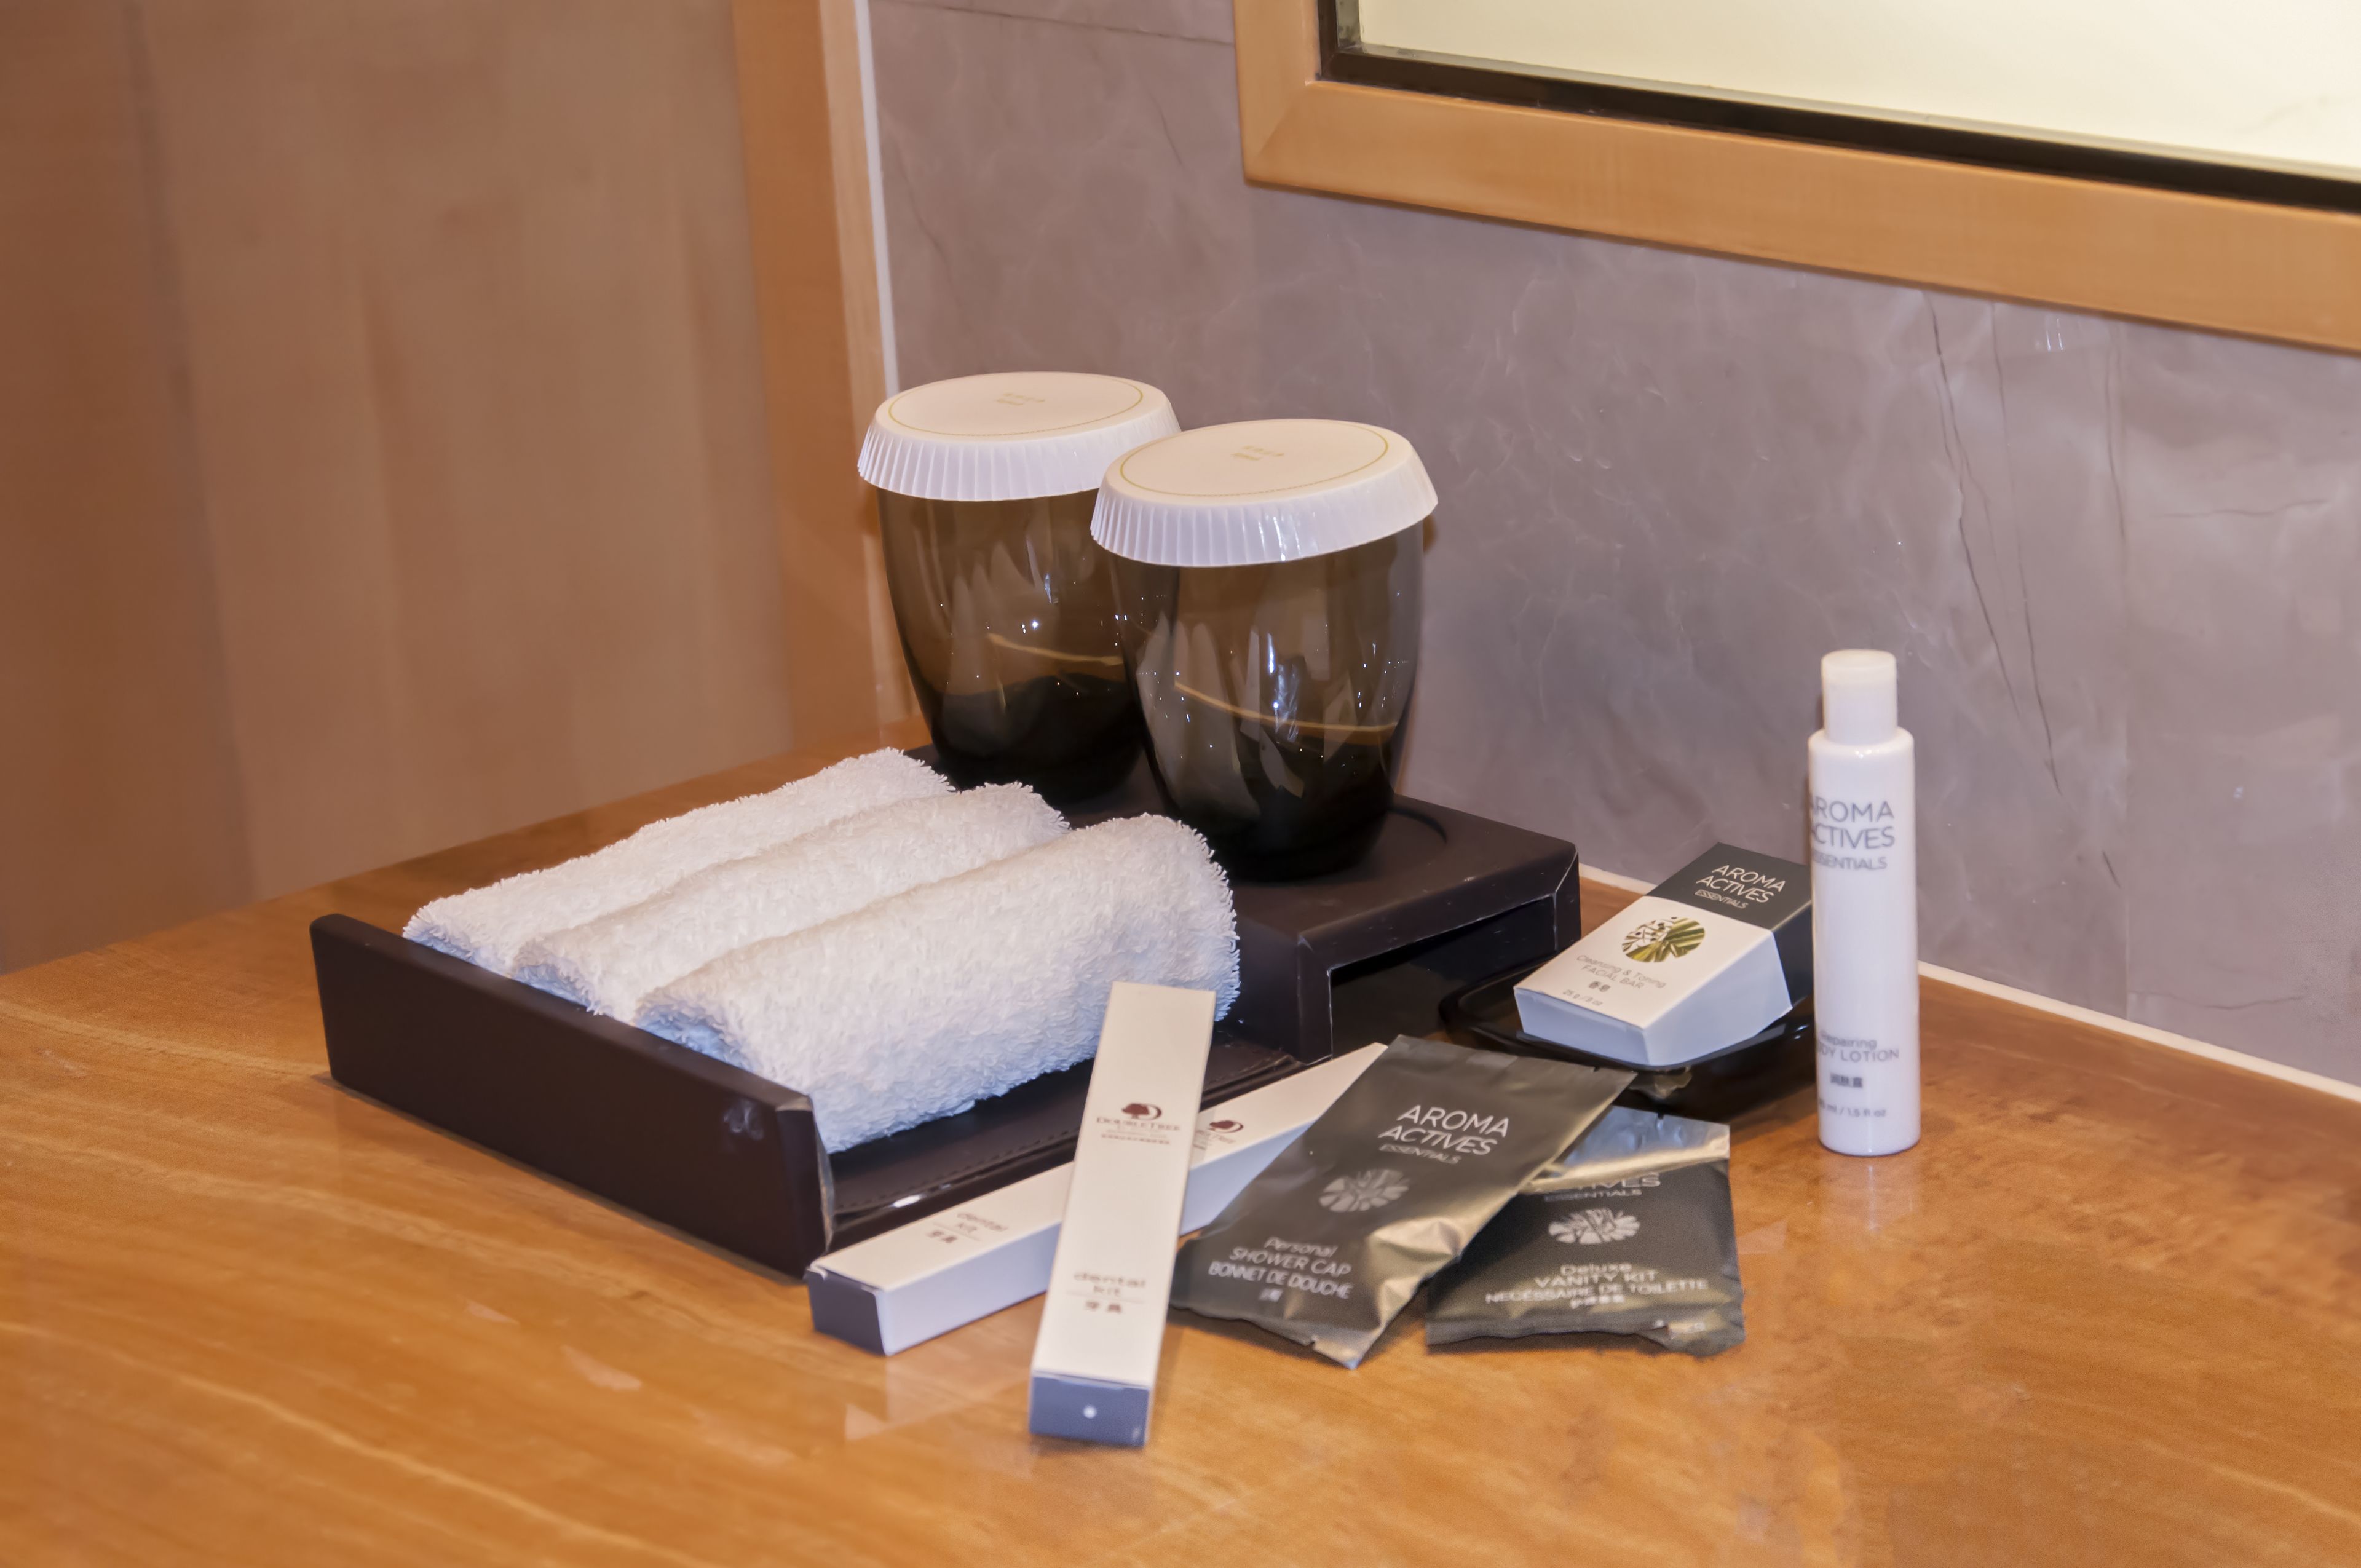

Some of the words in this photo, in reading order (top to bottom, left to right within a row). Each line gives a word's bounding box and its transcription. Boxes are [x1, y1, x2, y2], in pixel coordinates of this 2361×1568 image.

[1811, 796, 1894, 823] ROMA
[1811, 823, 1896, 850] CTIVES
[1696, 875, 1774, 903] ACTIVES
[1711, 865, 1786, 892] AROMA
[1695, 889, 1749, 909] ESSENTIALS
[1581, 964, 1618, 982] FACIAL
[1619, 978, 1645, 989] BAR
[1840, 1049, 1900, 1063] LOTION
[1396, 1104, 1509, 1138] AROMA
[1378, 1125, 1498, 1155] ACTIVES
[1378, 1143, 1462, 1165] ESSENTIALS
[1264, 1236, 1338, 1259] Personal
[1229, 1246, 1309, 1270] SHOWER
[1310, 1259, 1353, 1277] CAP
[1074, 1273, 1146, 1288] dental
[1208, 1261, 1267, 1282] BONNET
[1265, 1269, 1290, 1286] DE
[1287, 1272, 1353, 1299] DOUCHE
[1534, 1272, 1620, 1288] VANITY
[1623, 1269, 1656, 1282] KIT
[1598, 1283, 1624, 1294] DE
[1629, 1278, 1709, 1294] TOILETTE
